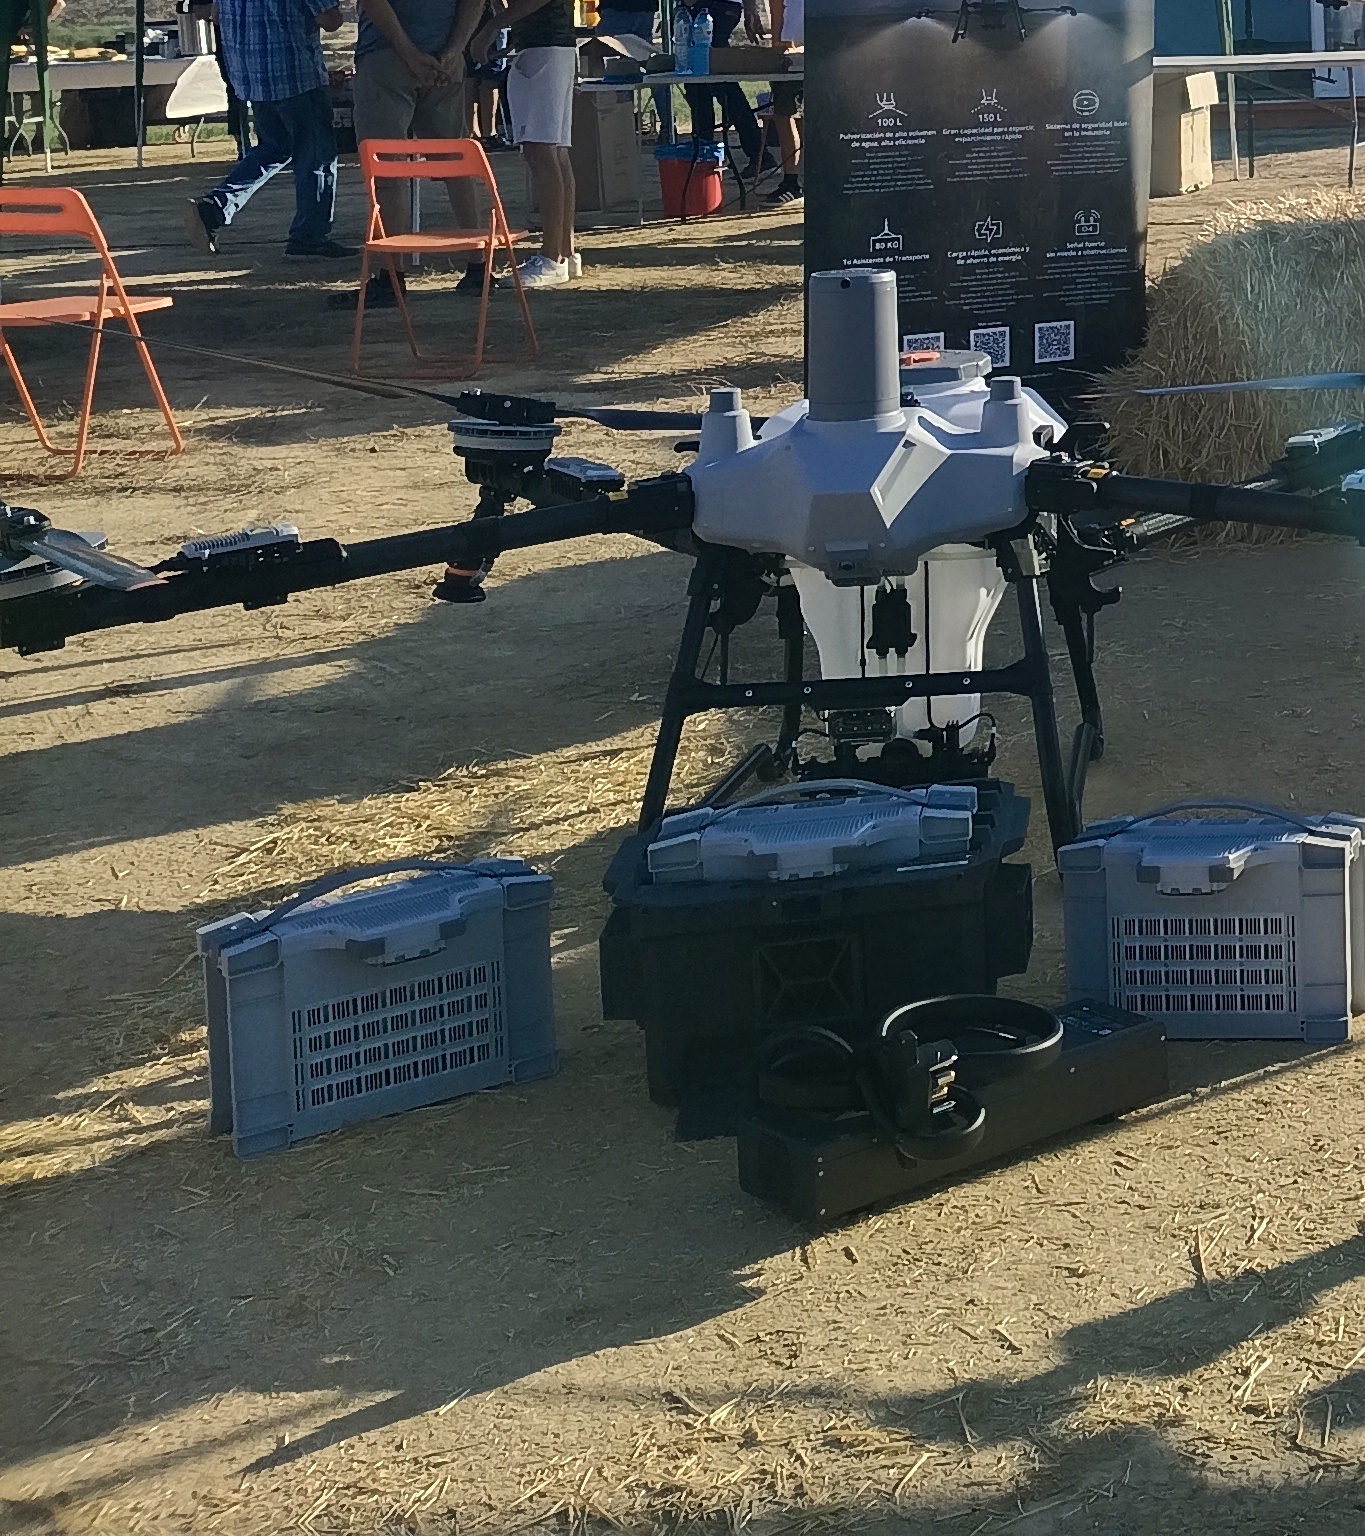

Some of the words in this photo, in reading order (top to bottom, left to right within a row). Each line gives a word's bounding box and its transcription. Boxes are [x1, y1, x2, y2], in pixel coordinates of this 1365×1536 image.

[877, 118, 894, 127] 100
[896, 117, 902, 126] L
[978, 114, 993, 123] 150
[996, 113, 1002, 122] L
